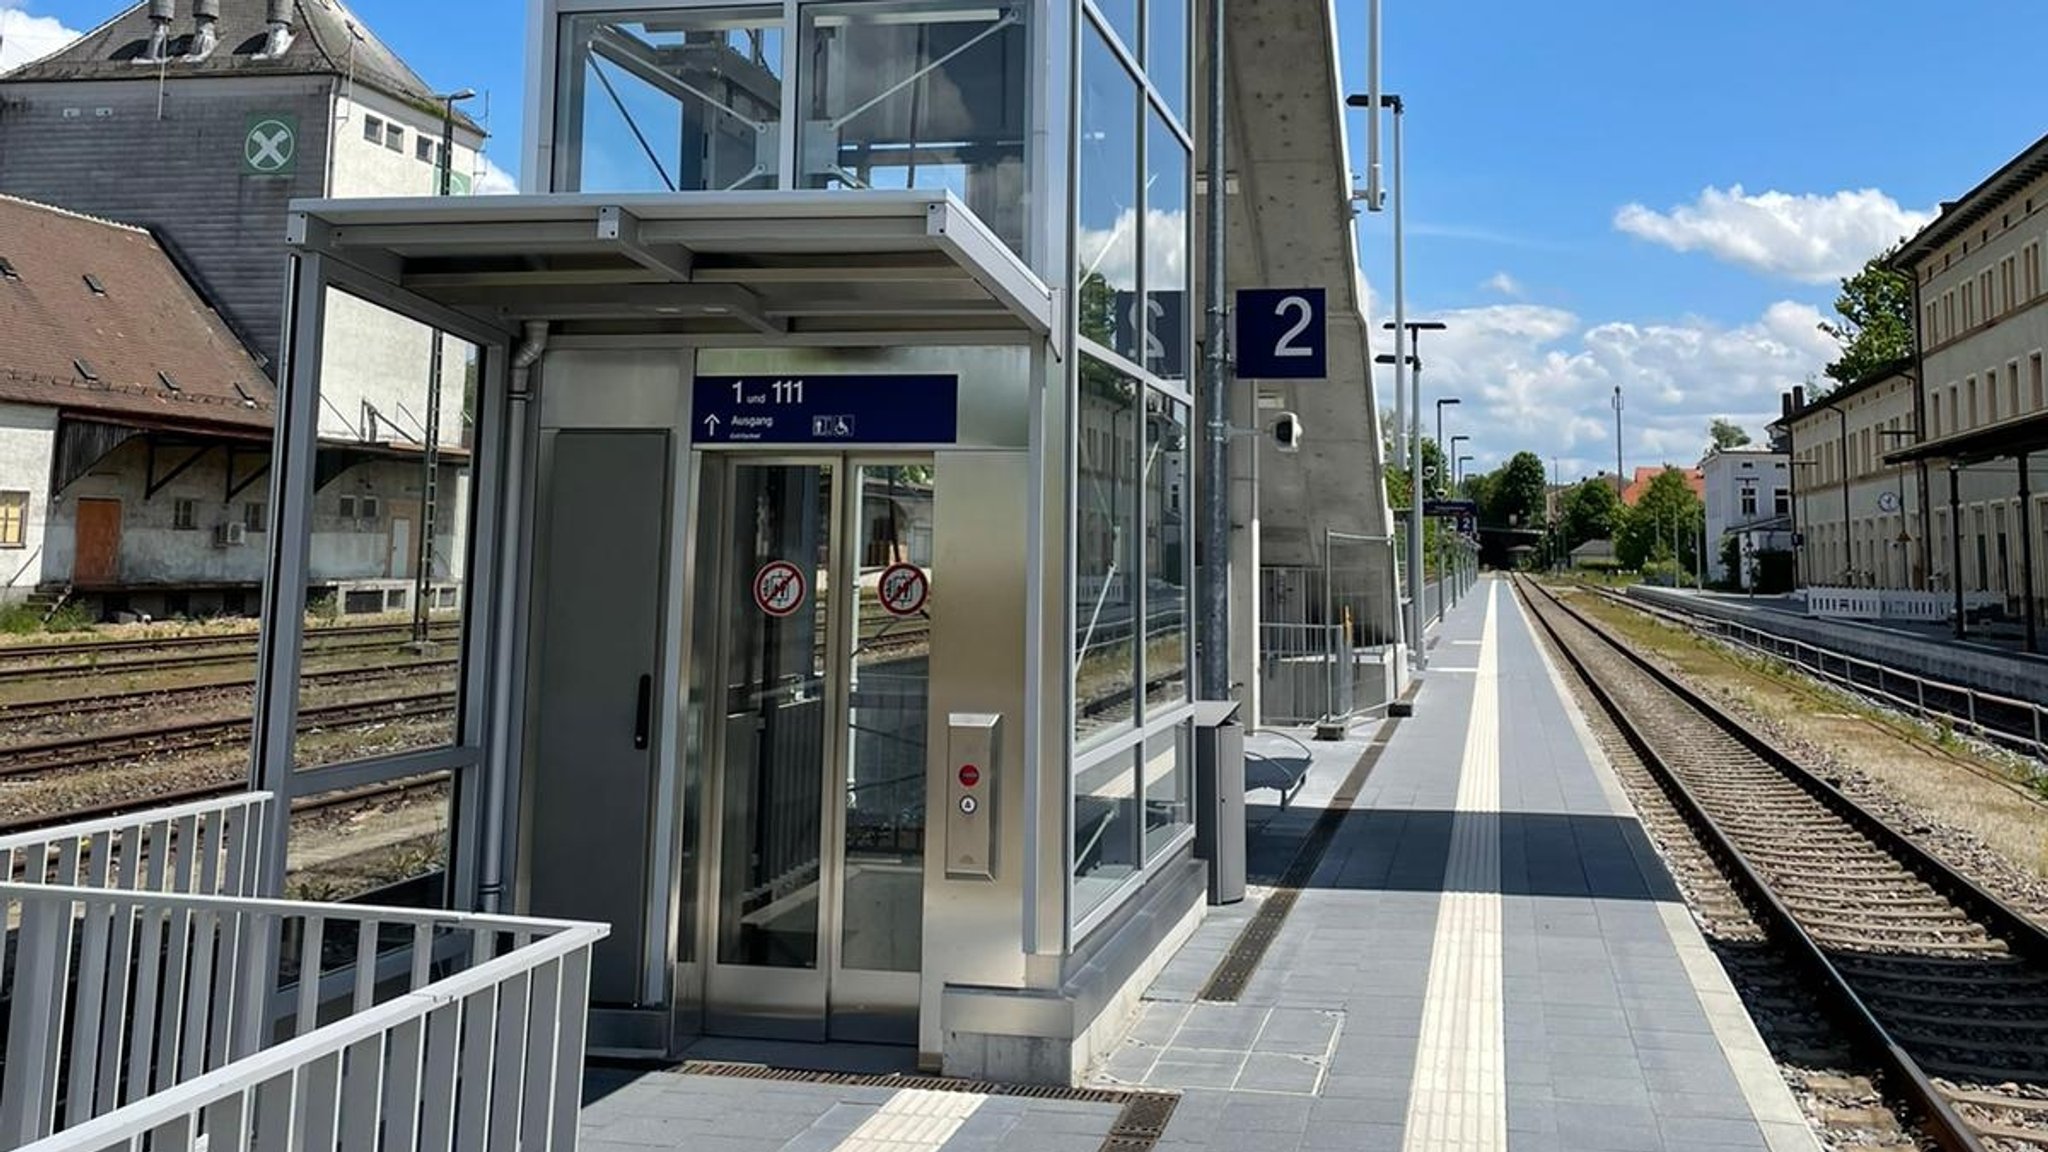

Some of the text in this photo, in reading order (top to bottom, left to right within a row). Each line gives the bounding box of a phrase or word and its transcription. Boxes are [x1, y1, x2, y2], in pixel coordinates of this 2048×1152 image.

[1275, 296, 1313, 357] 2
[732, 380, 803, 404] 1 und 111
[731, 415, 773, 428] Ausgang
[1462, 517, 1470, 529] 2
